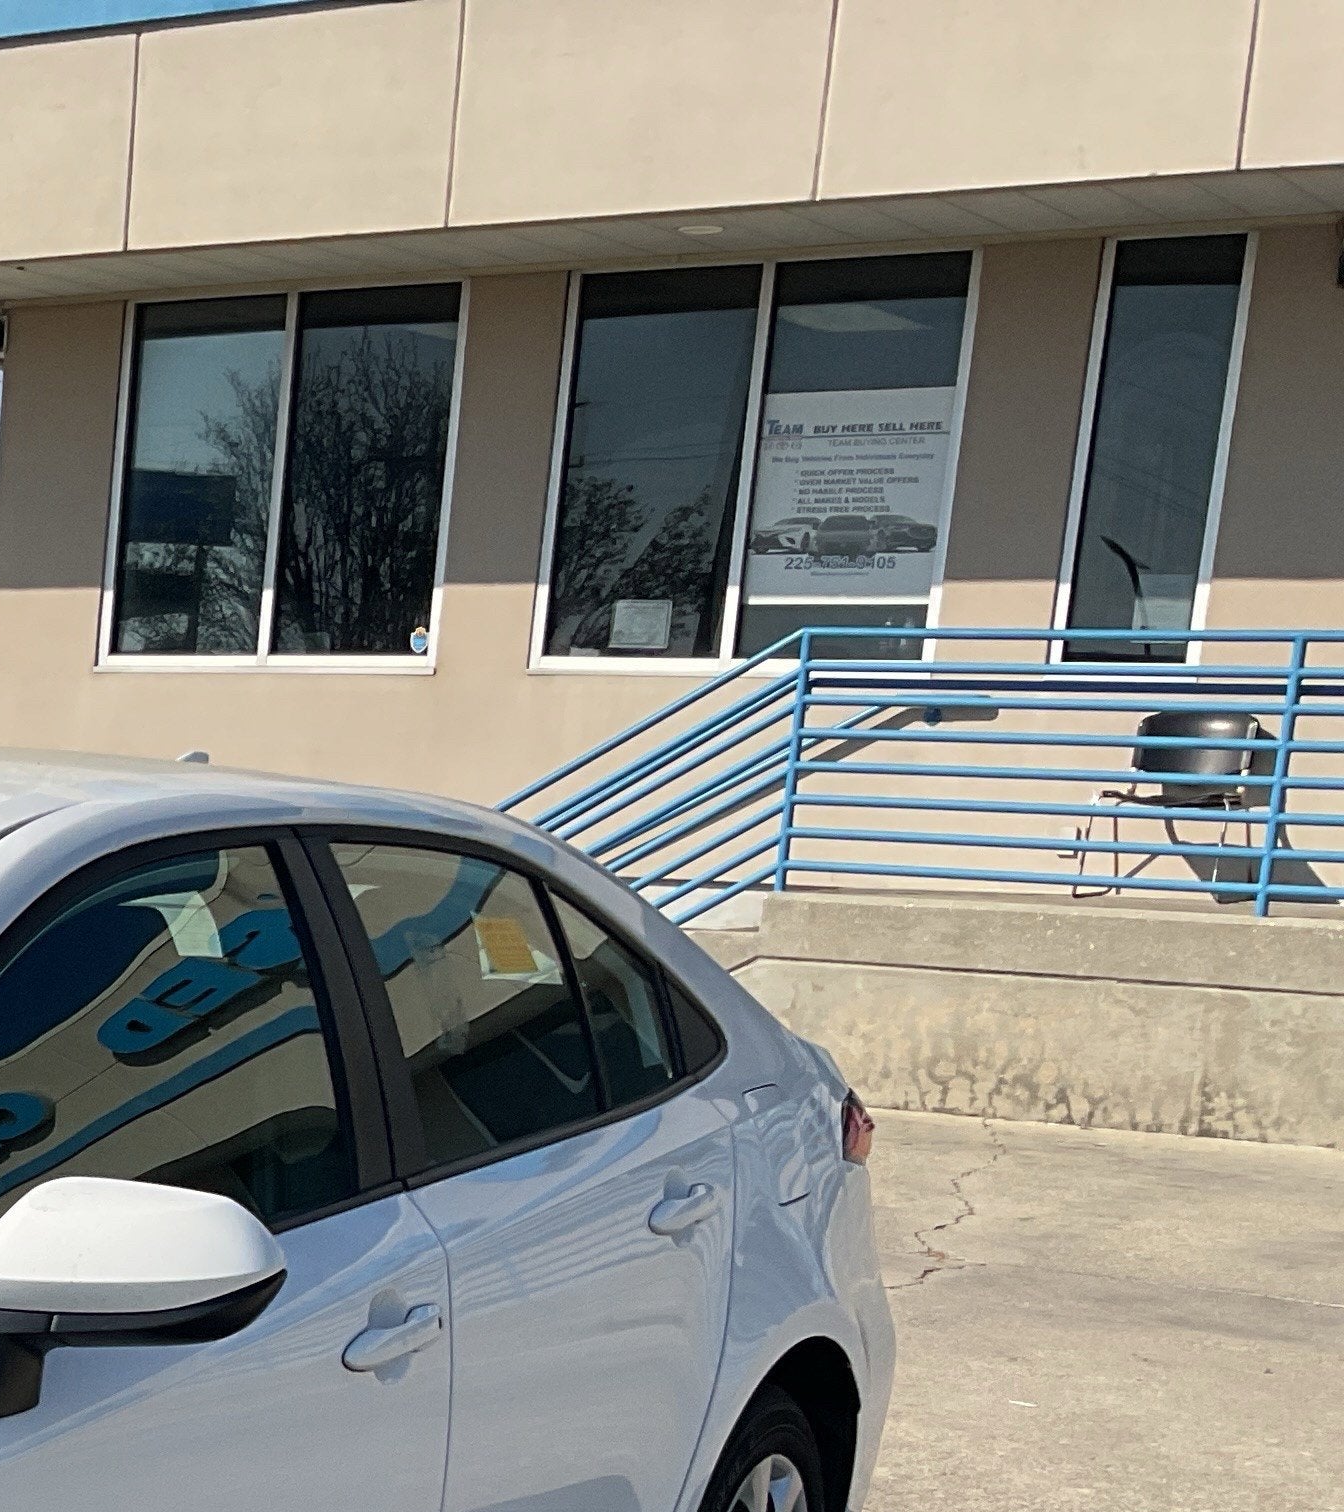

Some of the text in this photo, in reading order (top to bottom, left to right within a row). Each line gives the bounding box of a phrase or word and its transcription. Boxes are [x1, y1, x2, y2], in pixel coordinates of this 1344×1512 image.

[766, 419, 943, 435] TEAM BUY HERE SELL HERE
[827, 437, 926, 447] TEAM BUYING CENTER
[796, 506, 827, 514] STRESS
